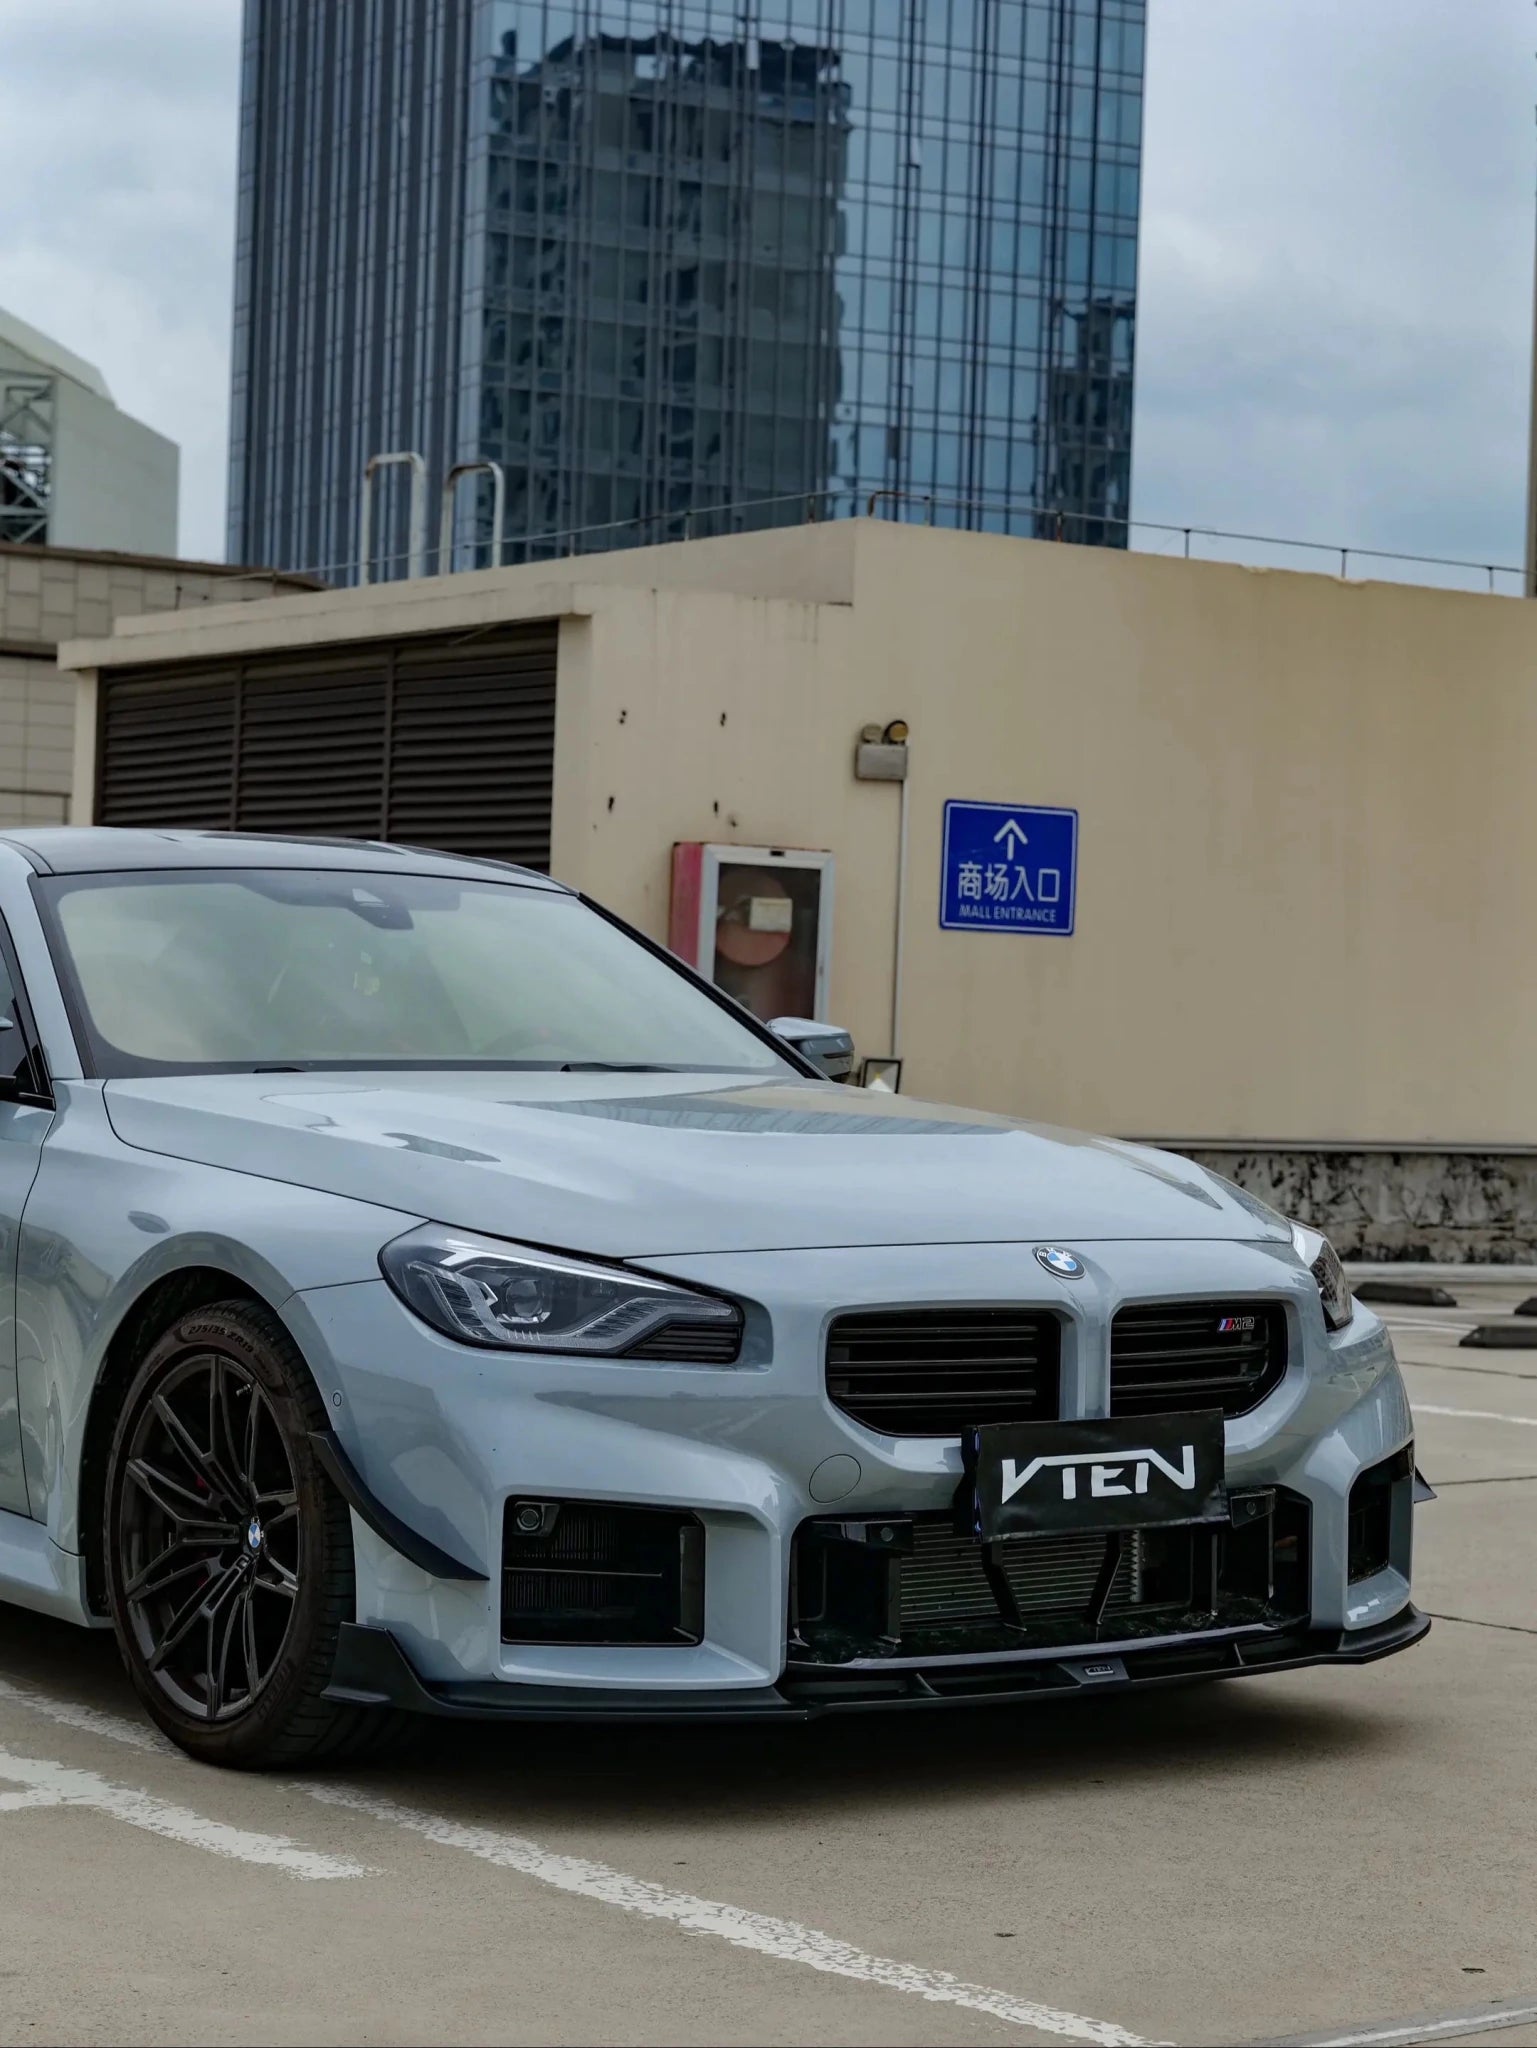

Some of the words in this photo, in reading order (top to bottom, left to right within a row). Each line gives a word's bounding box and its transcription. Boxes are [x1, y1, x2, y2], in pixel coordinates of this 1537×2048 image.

[958, 861, 1060, 902] 商场入口
[959, 904, 991, 919] MALL
[993, 906, 1056, 923] ENTRANCE
[188, 1324, 227, 1336] 275/35
[227, 1331, 254, 1353] ZR19
